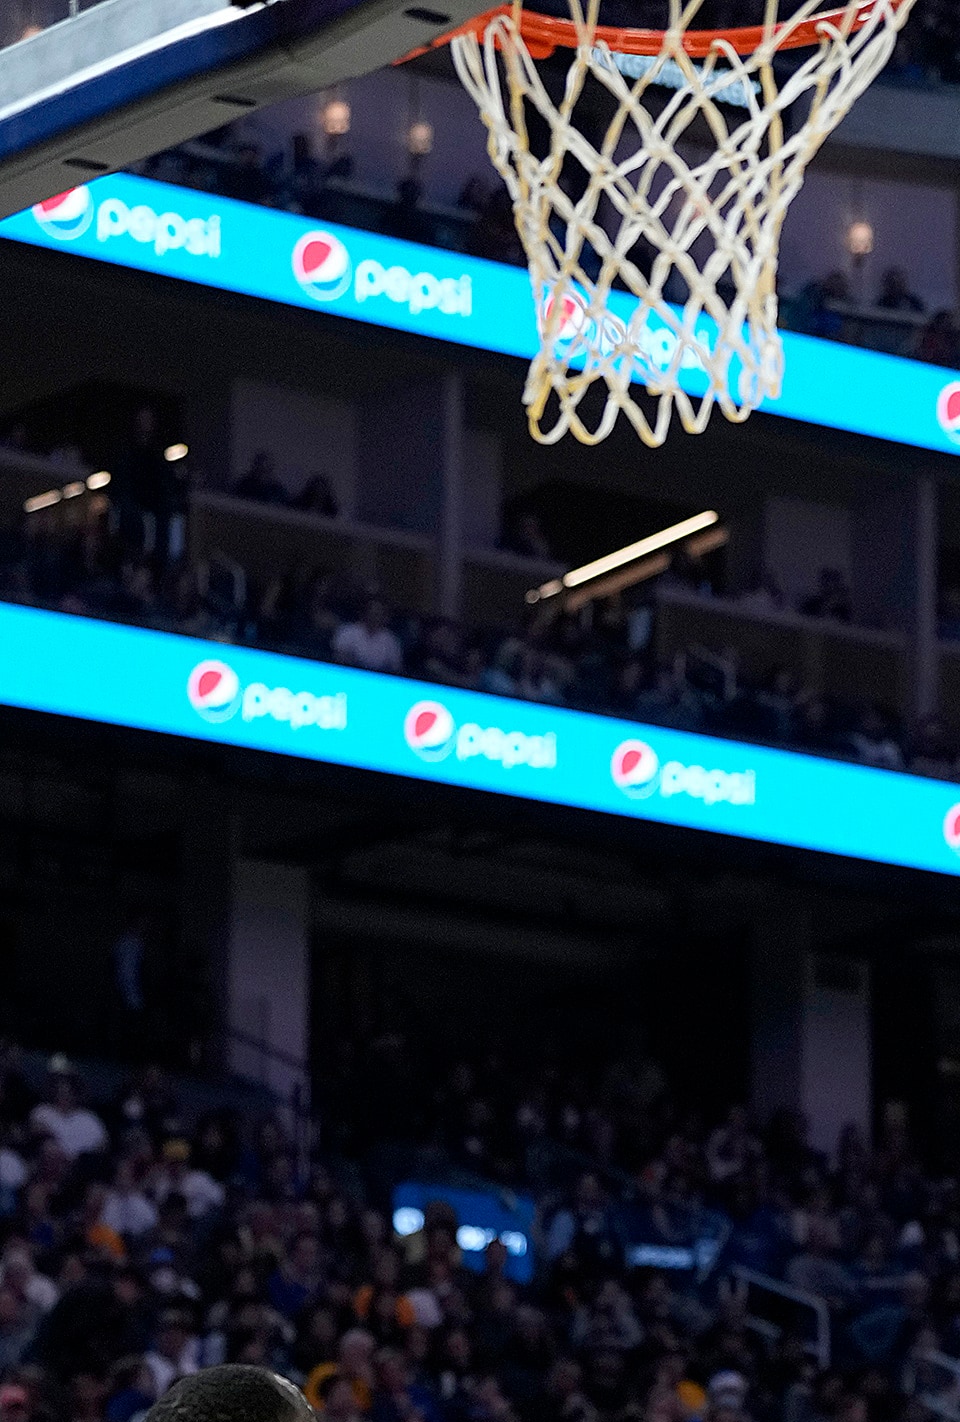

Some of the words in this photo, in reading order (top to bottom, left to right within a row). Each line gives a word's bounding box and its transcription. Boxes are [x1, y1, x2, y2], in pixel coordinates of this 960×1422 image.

[97, 198, 220, 257] pepsi
[355, 260, 472, 316] pepsi
[242, 683, 347, 730] pepsi
[456, 723, 556, 768] pepsi
[661, 761, 755, 804] pepsi
